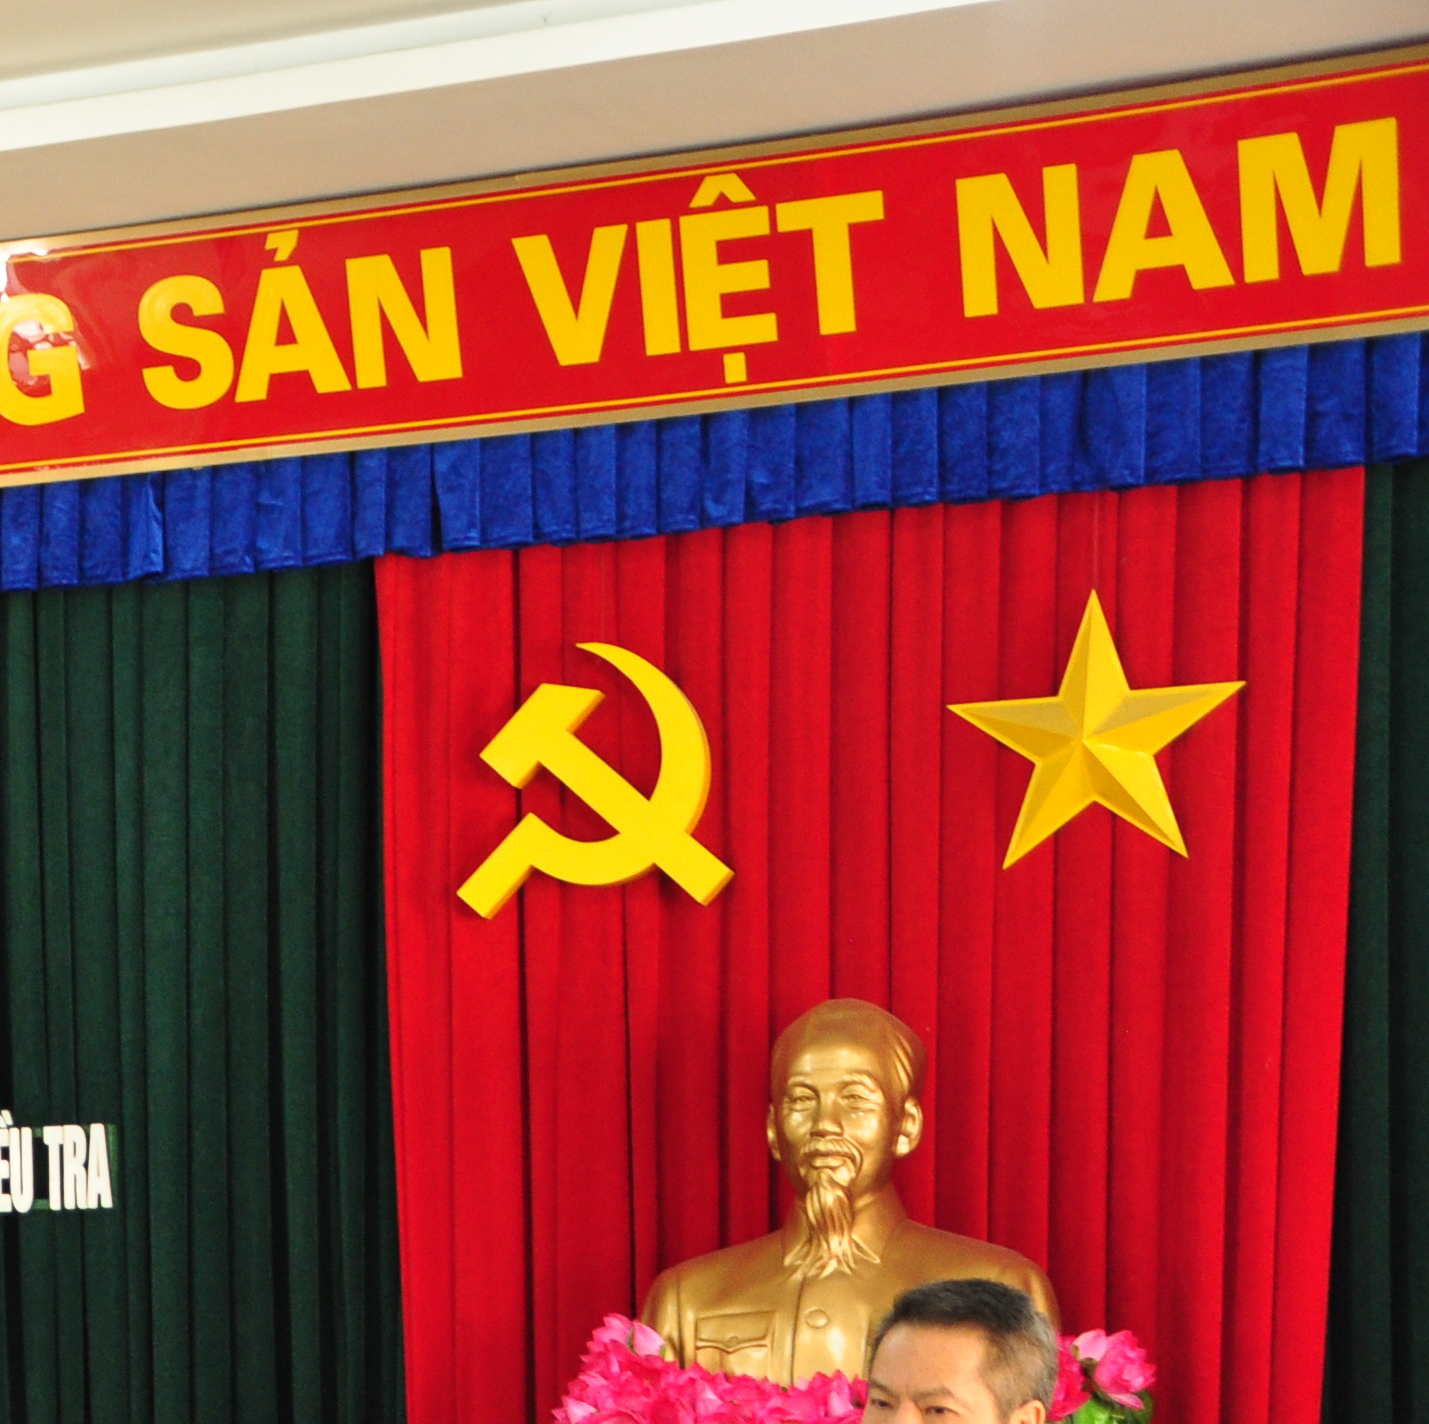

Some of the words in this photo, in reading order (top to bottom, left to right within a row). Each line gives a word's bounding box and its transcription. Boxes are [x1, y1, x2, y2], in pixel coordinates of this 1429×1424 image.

[138, 230, 463, 410] SẢN
[511, 173, 885, 384] VIỆT
[955, 117, 1401, 318] NAM
[43, 1123, 112, 1210] TRA
